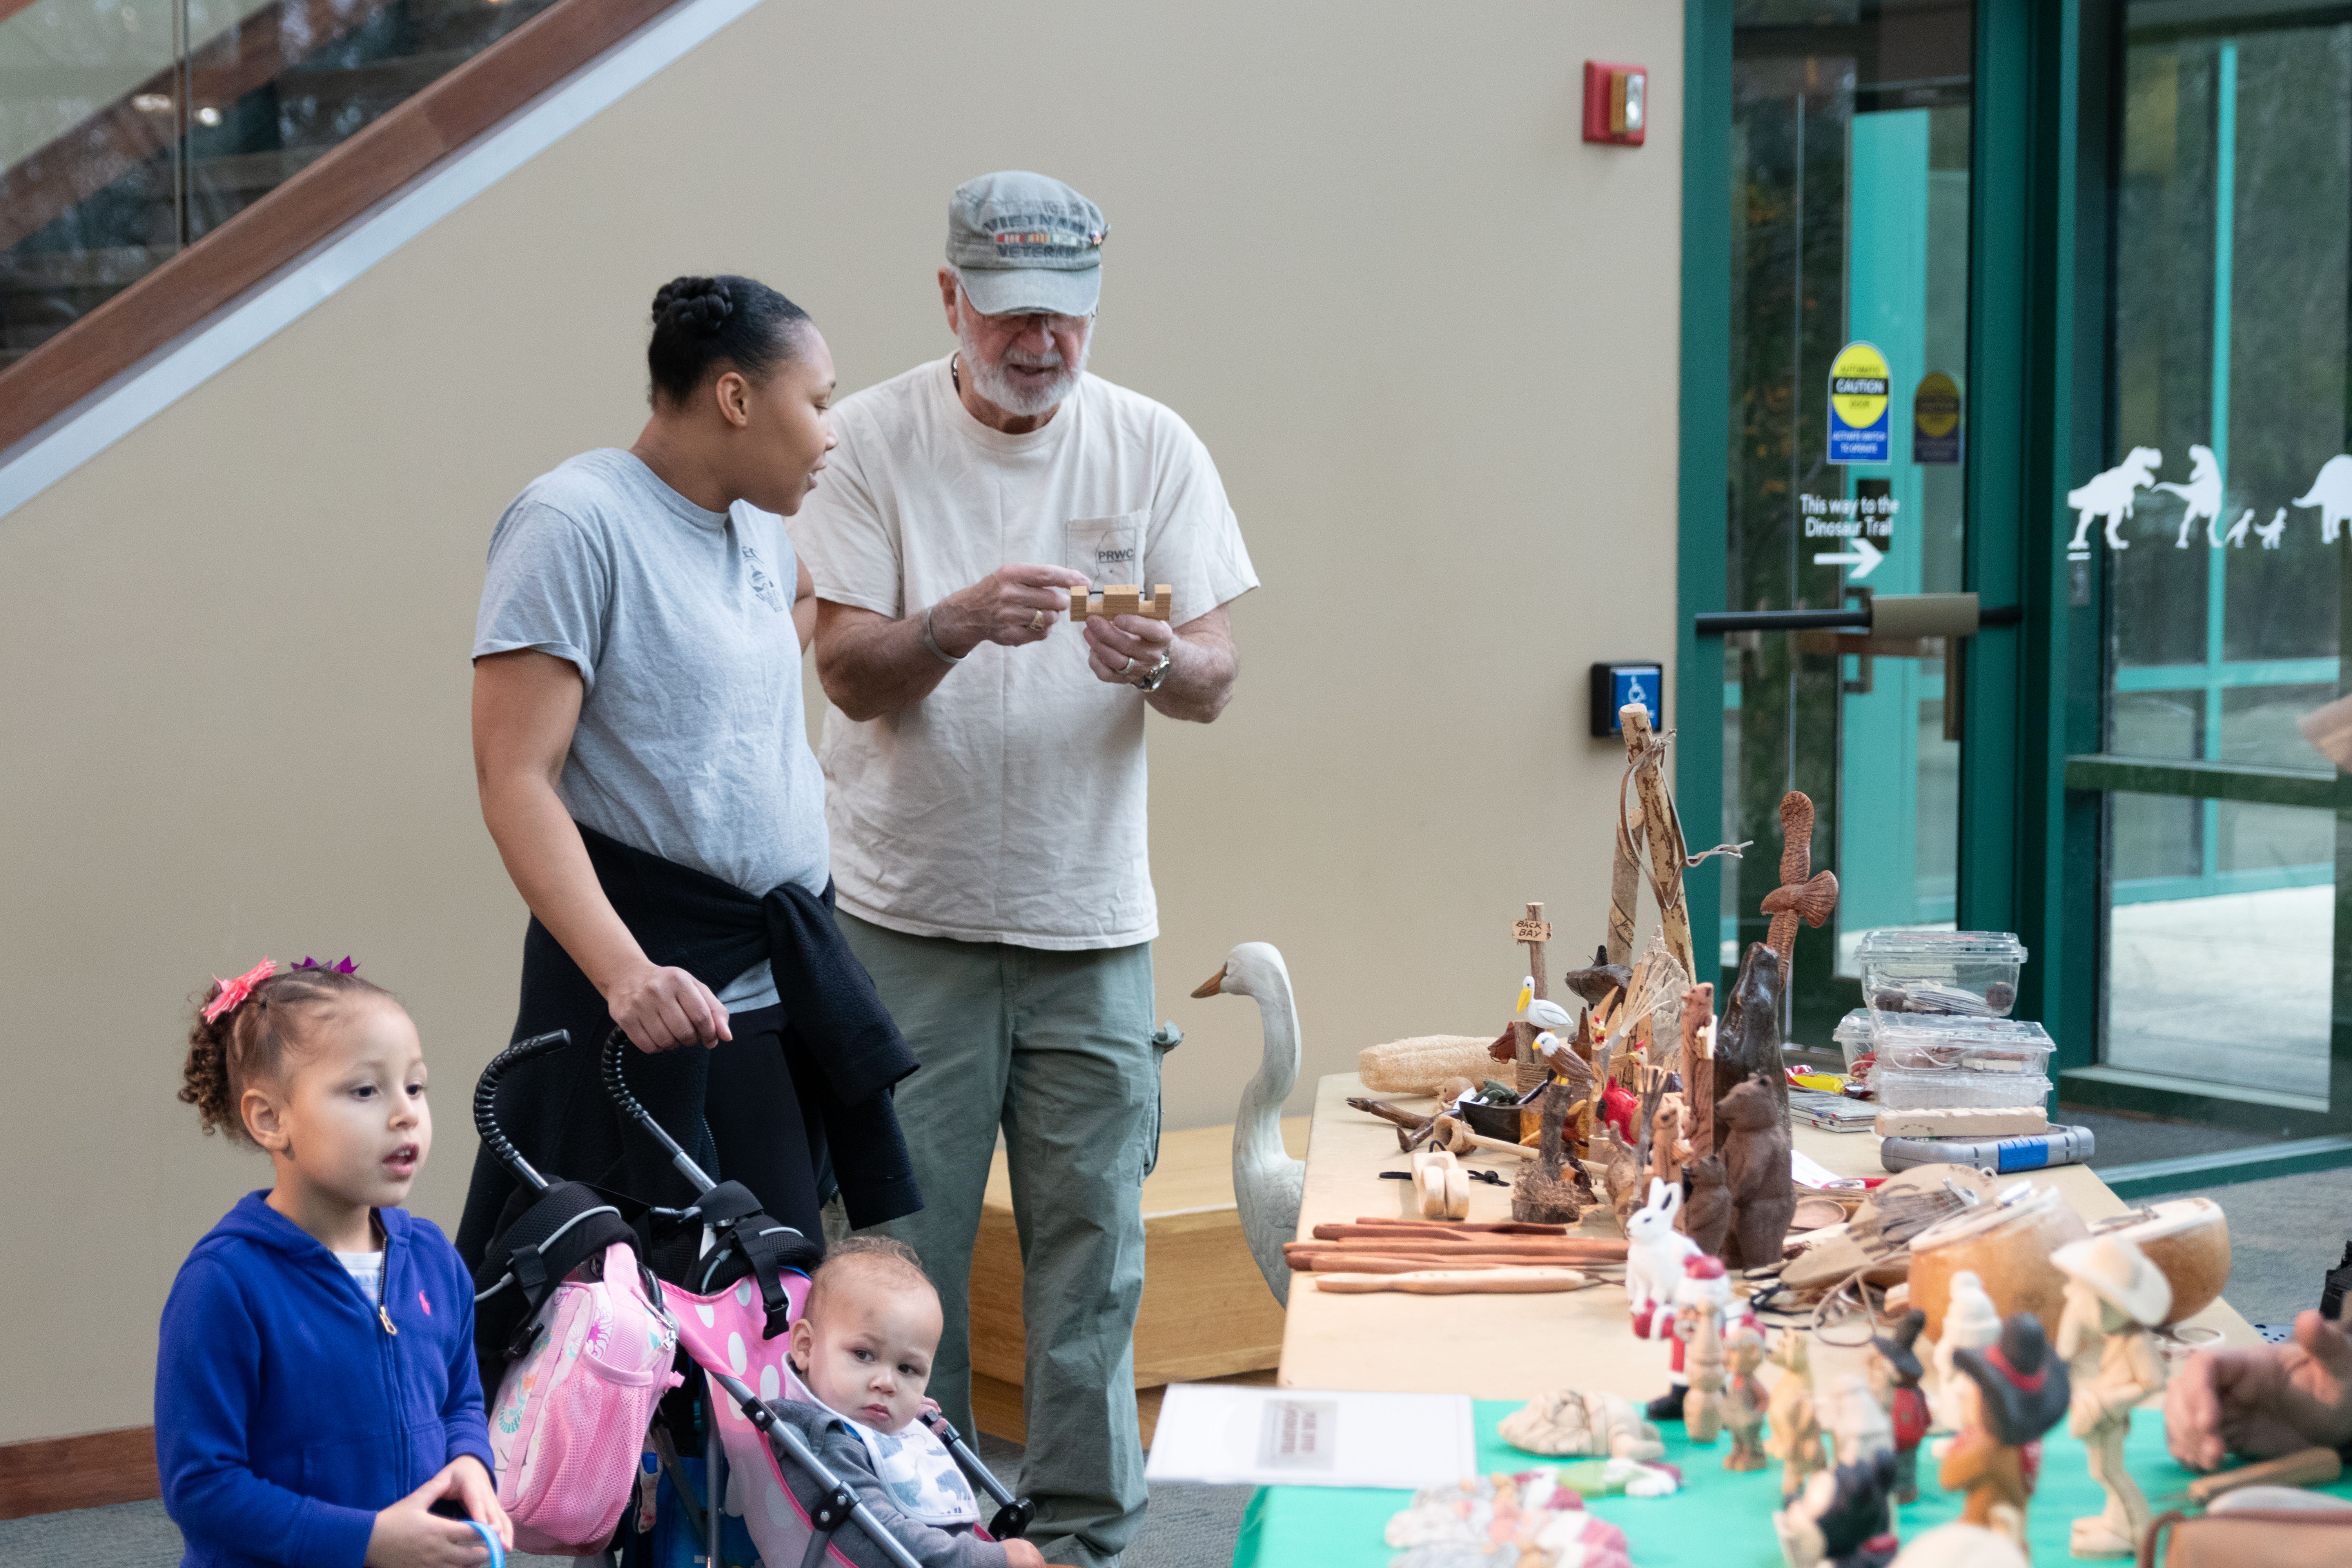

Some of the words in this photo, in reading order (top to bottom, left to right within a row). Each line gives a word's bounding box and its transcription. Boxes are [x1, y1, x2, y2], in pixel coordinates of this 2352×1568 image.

[984, 214, 1085, 236] VIETNAM
[997, 243, 1077, 258] VETERAN
[1836, 378, 1885, 394] CAUTION
[1800, 494, 1828, 514] This
[1829, 499, 1859, 519] way
[1860, 496, 1877, 514] to
[1878, 494, 1900, 514] the
[1805, 516, 1862, 537] Dinosaur
[1864, 516, 1893, 537] Trail
[1098, 548, 1133, 561] PRWC
[1515, 920, 1542, 929] BACK
[1518, 929, 1541, 938] BAY
